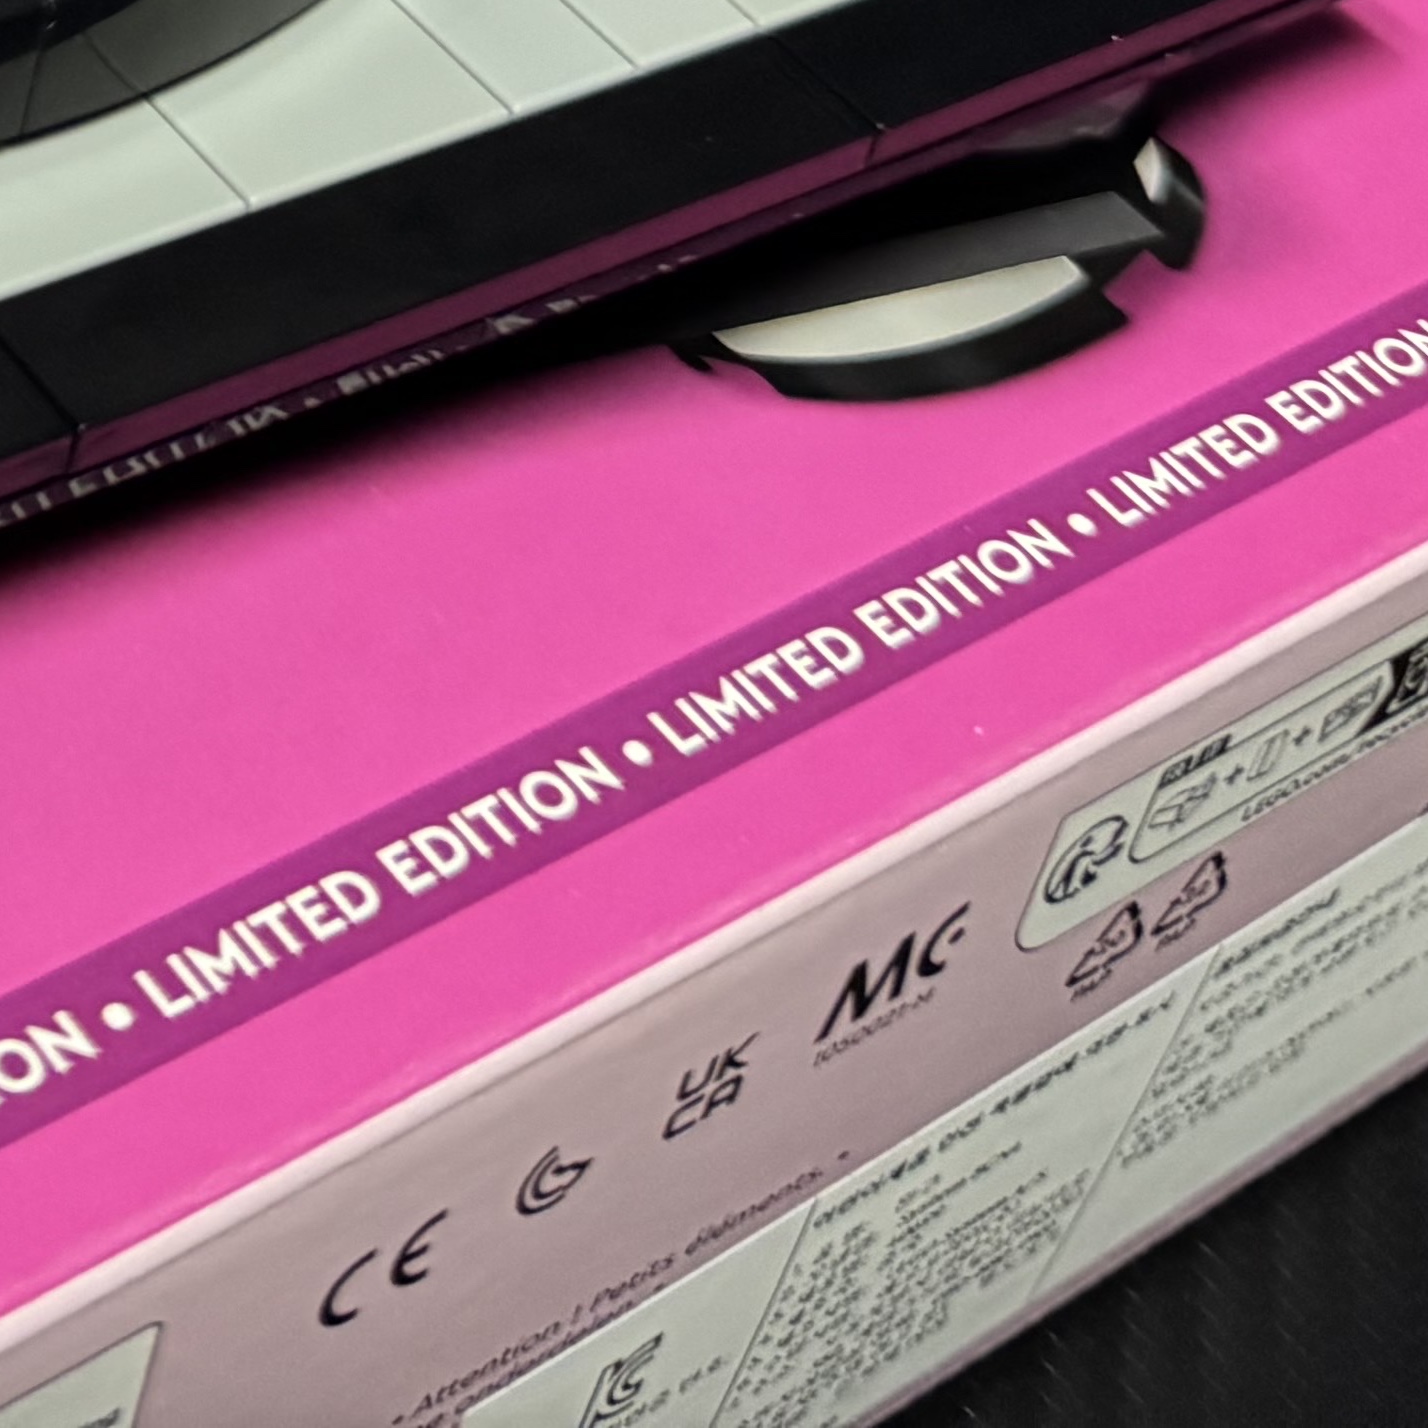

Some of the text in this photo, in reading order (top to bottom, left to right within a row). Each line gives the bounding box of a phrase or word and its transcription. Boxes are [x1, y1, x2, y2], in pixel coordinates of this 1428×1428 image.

[133, 870, 382, 1021] LIMITED
[376, 747, 625, 897] EDITION
[647, 625, 864, 757] LIMITED
[853, 517, 1075, 650] EDITION
[1086, 412, 1282, 529] LIMITED
[662, 1073, 743, 1141] CA
[676, 1030, 761, 1101] UK
[319, 1209, 450, 1327] CE
